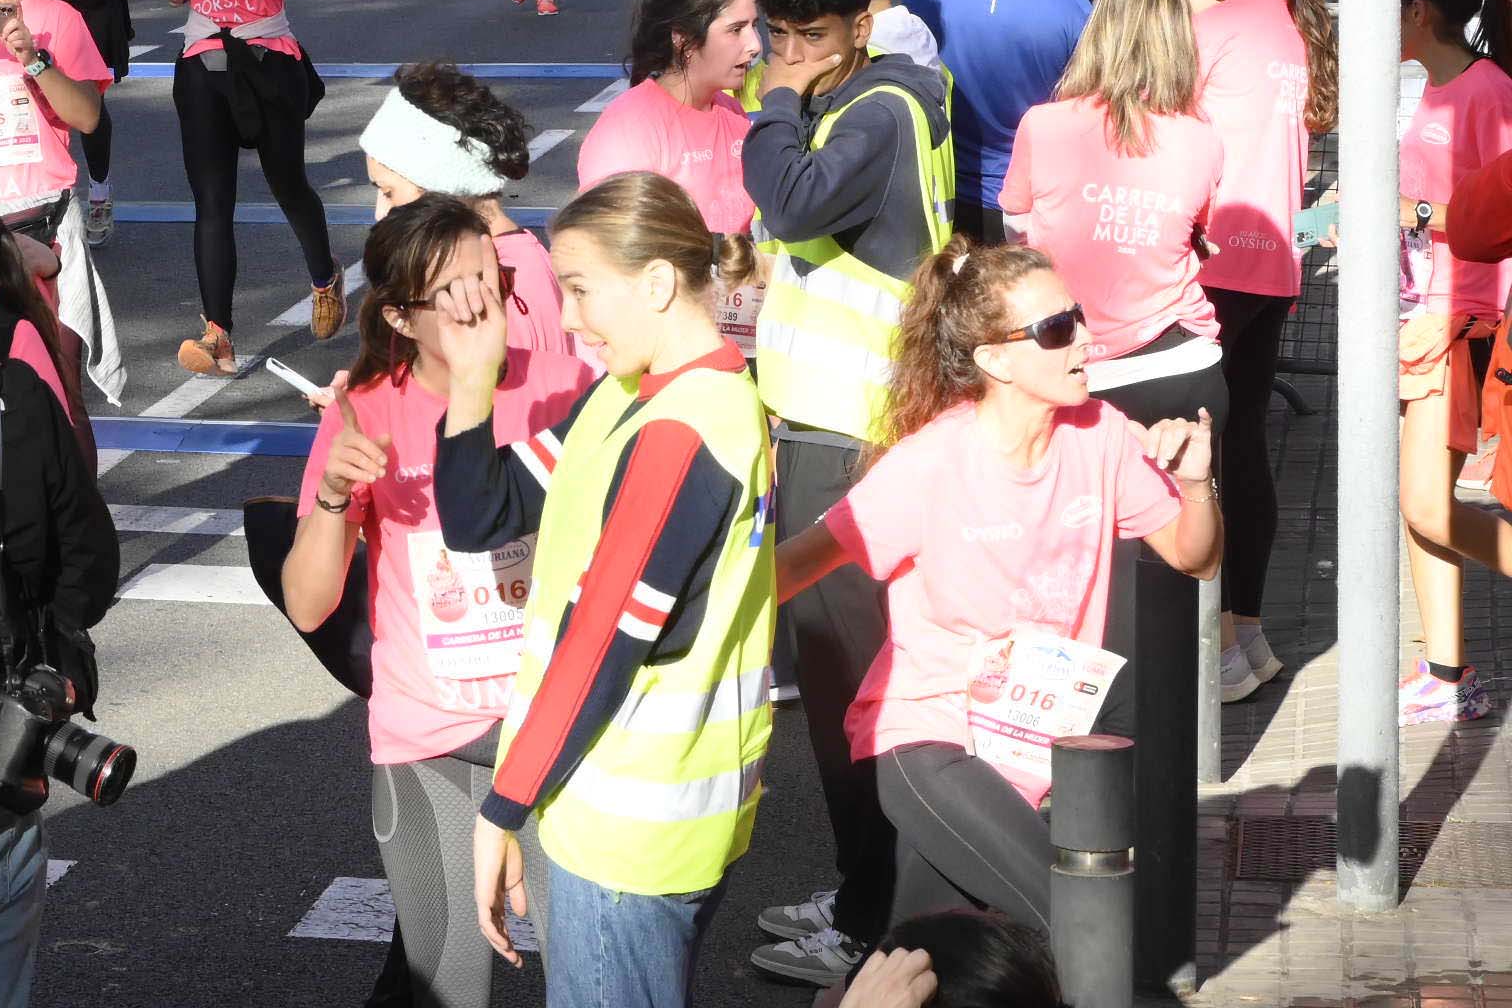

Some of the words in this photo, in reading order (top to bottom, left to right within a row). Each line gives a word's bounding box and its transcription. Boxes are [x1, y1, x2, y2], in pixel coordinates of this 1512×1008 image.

[1081, 183, 1184, 215] CARRERA
[1099, 204, 1129, 224] DE
[1133, 210, 1159, 228] LA
[1092, 223, 1160, 248] MUJER
[1228, 235, 1277, 252] OYSHO
[395, 463, 433, 483] OYS
[474, 579, 527, 606] 016
[1010, 683, 1055, 711] 016
